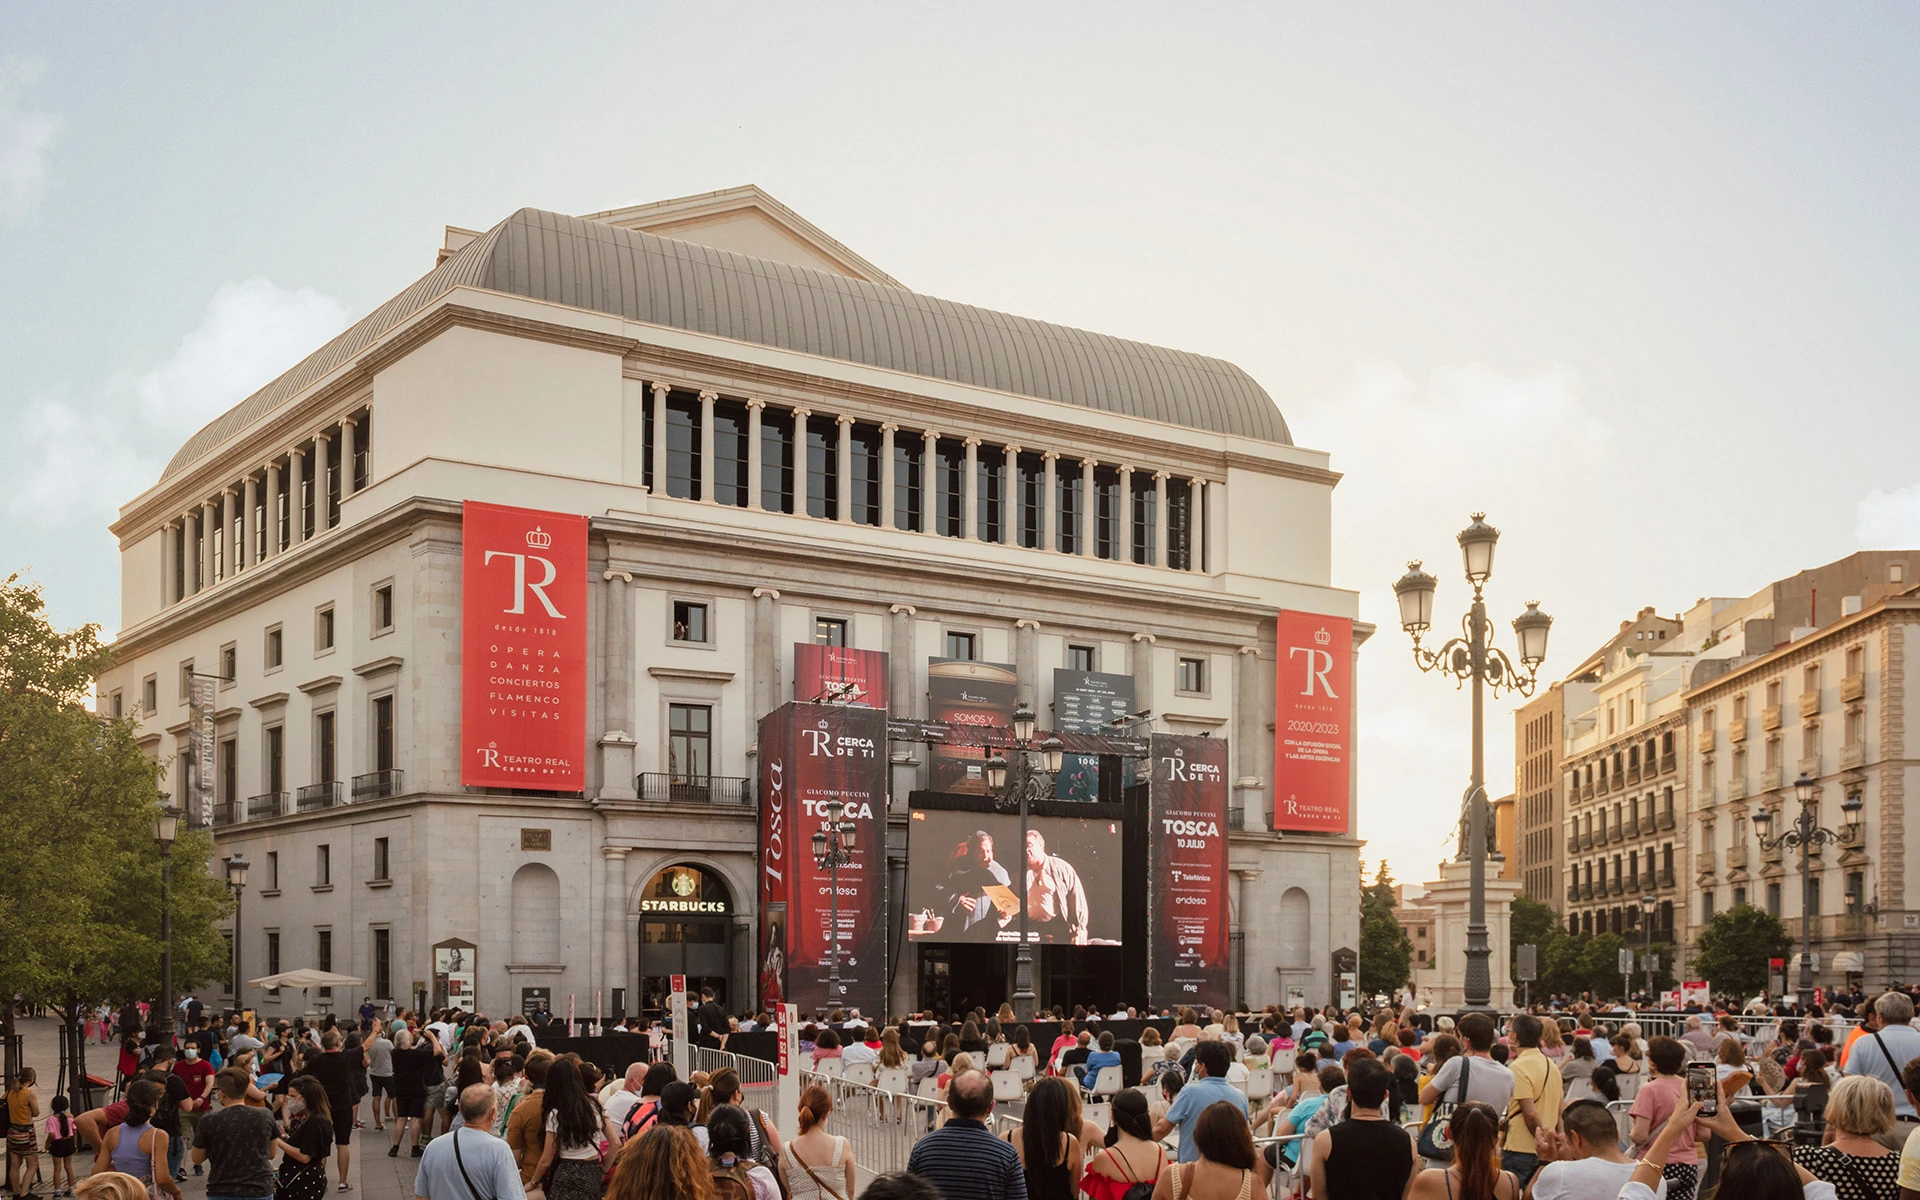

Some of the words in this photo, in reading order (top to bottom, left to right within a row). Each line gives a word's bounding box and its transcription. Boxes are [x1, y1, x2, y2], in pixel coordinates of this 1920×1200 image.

[494, 624, 526, 633] desde
[534, 627, 557, 636] 1818
[490, 644, 560, 658] ÓPERA
[490, 660, 560, 674] DANZA
[490, 676, 560, 689] CONCIERTOS
[490, 692, 560, 705] FLAMENCO
[490, 708, 560, 720] VISITAS
[954, 712, 986, 724] SOMOS
[986, 715, 994, 724] Y
[1287, 719, 1339, 735] 2020/2023
[836, 736, 874, 748] CERCA
[836, 747, 854, 757] DE
[861, 749, 874, 758] TI
[503, 755, 542, 765] TEATRO
[545, 757, 571, 767] REAL
[1189, 763, 1220, 773] CERCA
[1189, 773, 1204, 781] DE
[1210, 774, 1220, 782] TI
[806, 788, 840, 796] GIACOMO
[841, 790, 870, 798] PUCCINI
[802, 799, 874, 819] TOCA
[1165, 809, 1192, 817] GIACOMO
[765, 758, 783, 892] Tosca
[1162, 819, 1220, 837] TOSCA
[1177, 838, 1185, 848] 10
[1185, 839, 1206, 849] JULIO
[1182, 873, 1211, 881] Telefónica
[641, 900, 725, 912] STARBUCKS
[1175, 896, 1207, 905] endesa
[1183, 983, 1198, 993] rtve
[778, 1011, 786, 1025] B4
[779, 1026, 786, 1039] B3
[779, 1041, 787, 1054] B2
